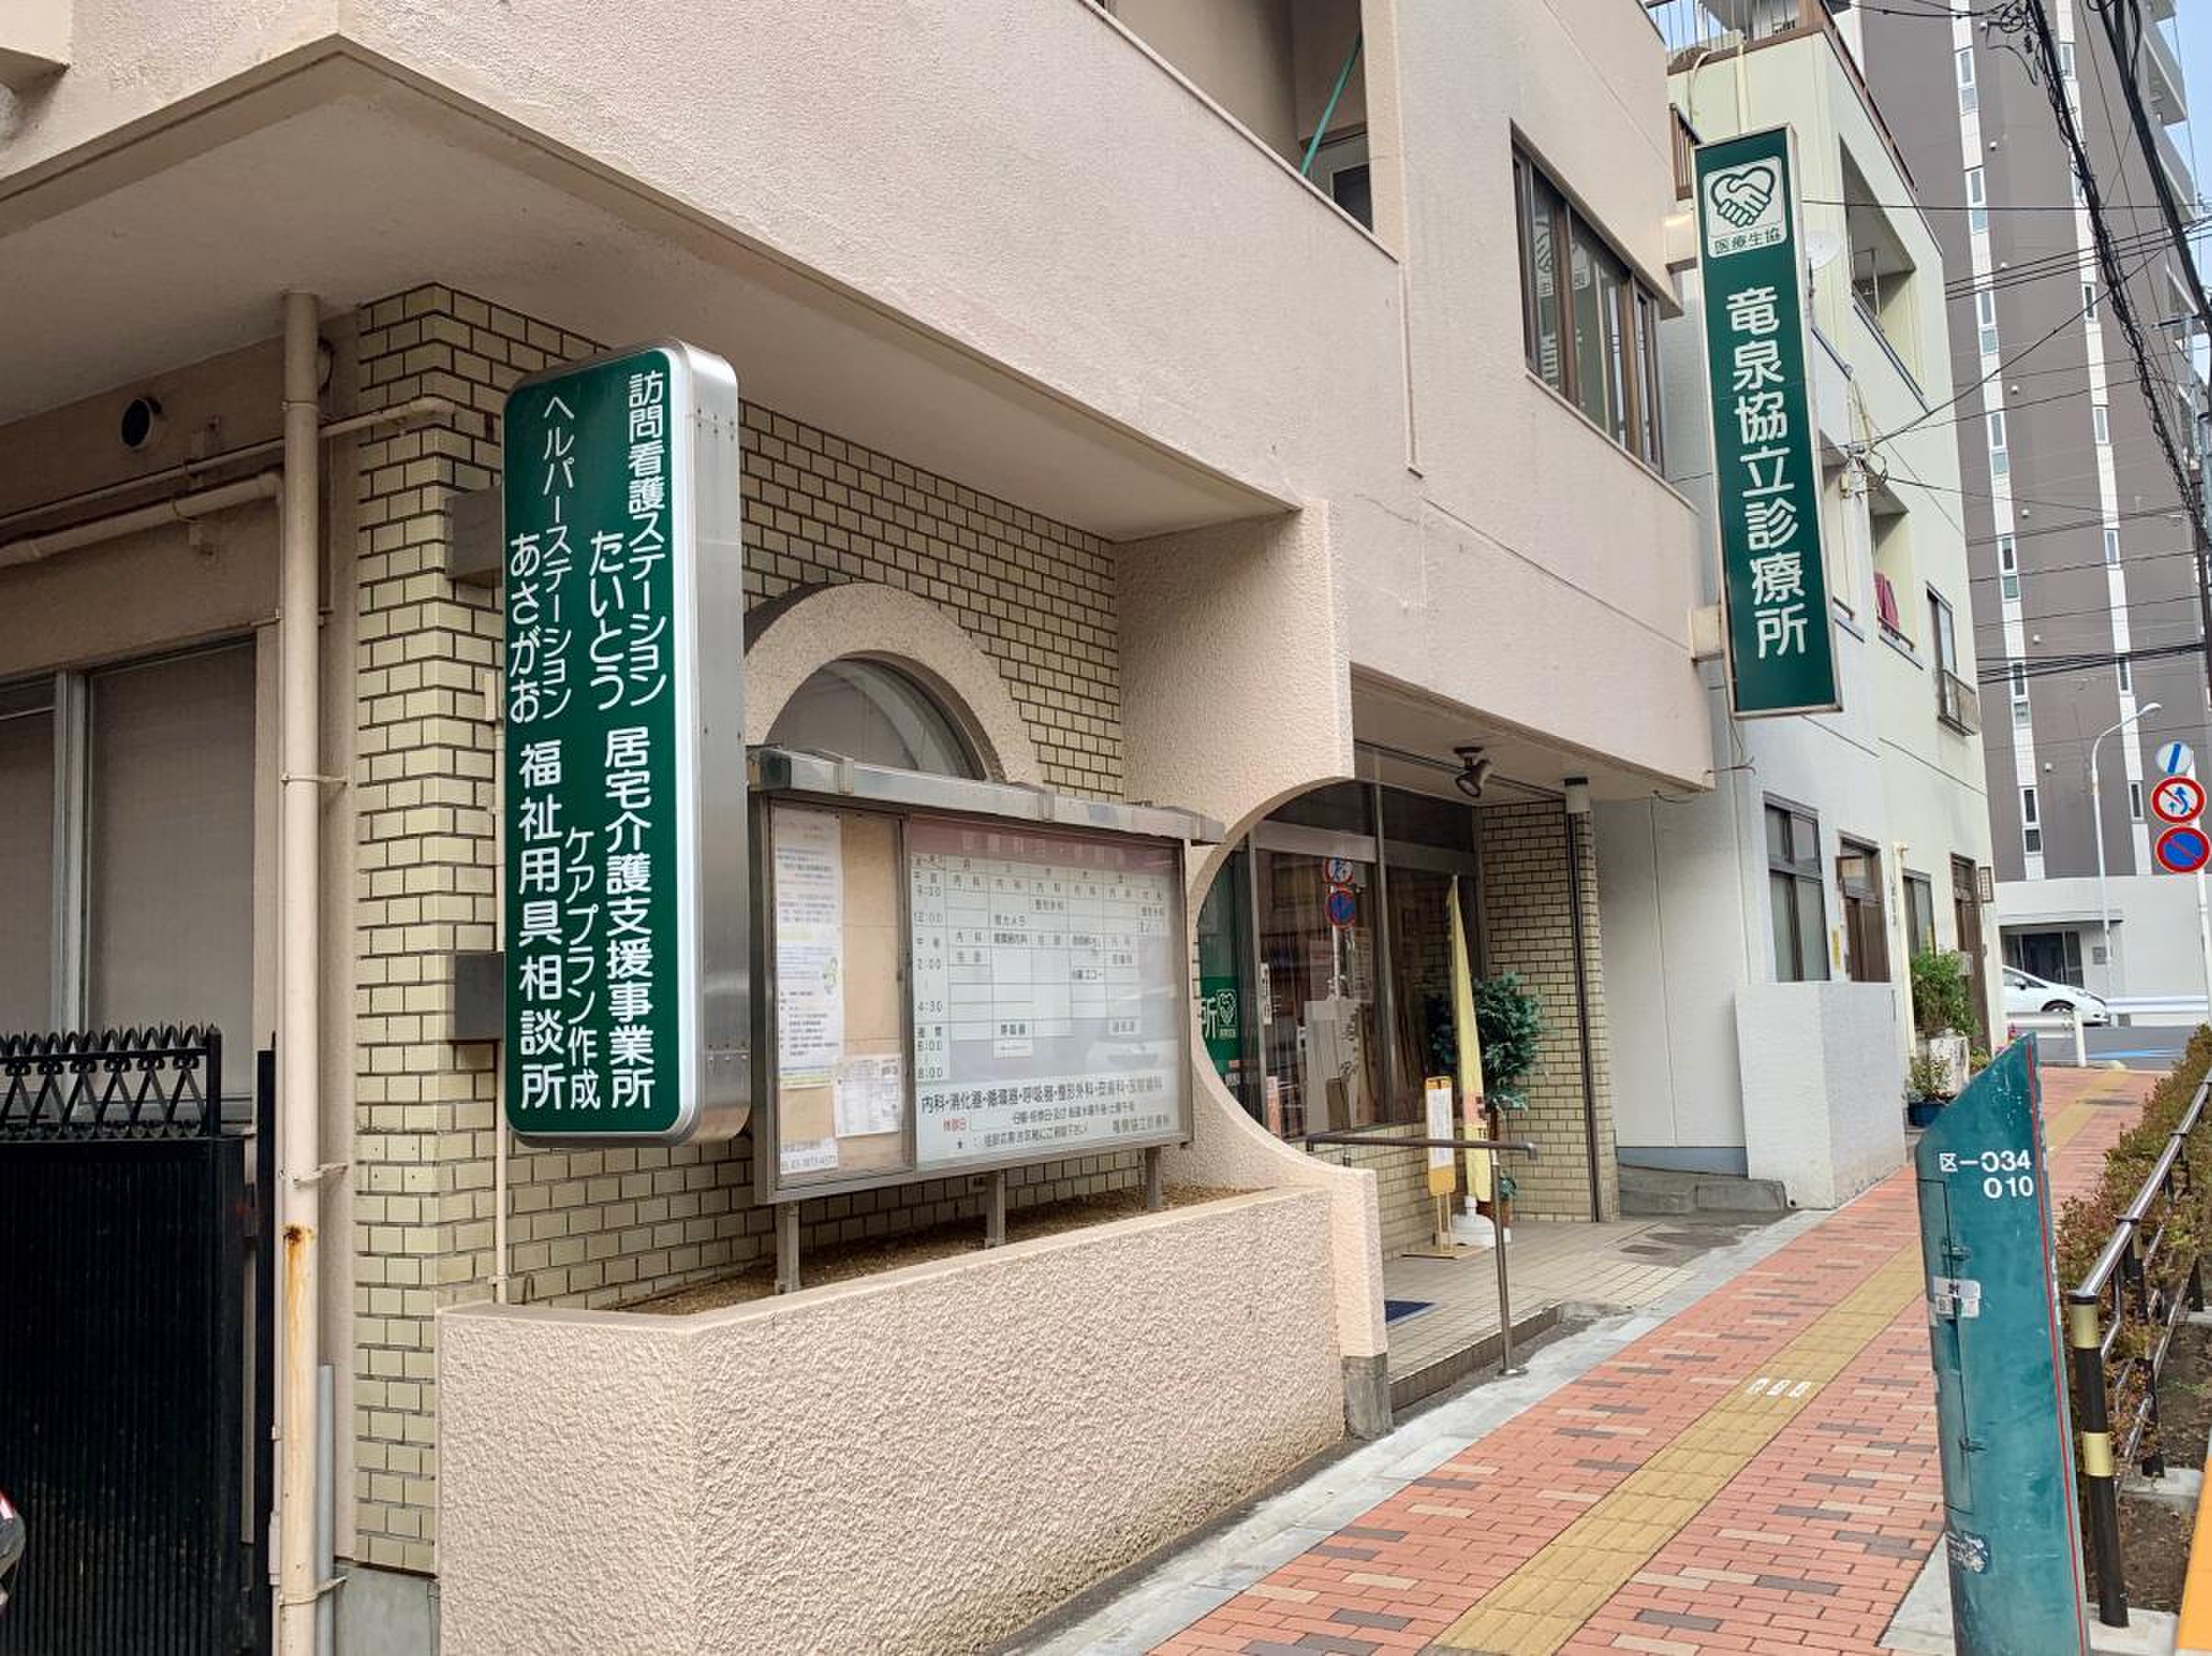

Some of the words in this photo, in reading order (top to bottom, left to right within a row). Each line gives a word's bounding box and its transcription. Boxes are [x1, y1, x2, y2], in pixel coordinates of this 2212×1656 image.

[1713, 226, 1782, 256] 医療生協
[542, 396, 575, 720] ヘルパーステーション
[588, 530, 625, 711] たいとう
[628, 370, 667, 707] 訪問看護ステーション
[1726, 285, 1808, 660] 竜泉協立診療所
[510, 532, 541, 725] あさがお
[517, 738, 568, 1111] 福祉用具相談所
[564, 825, 601, 1110] ケアプラン作成
[605, 725, 656, 1110] 居宅介護支援事業所
[1983, 1175, 2034, 1199] 010
